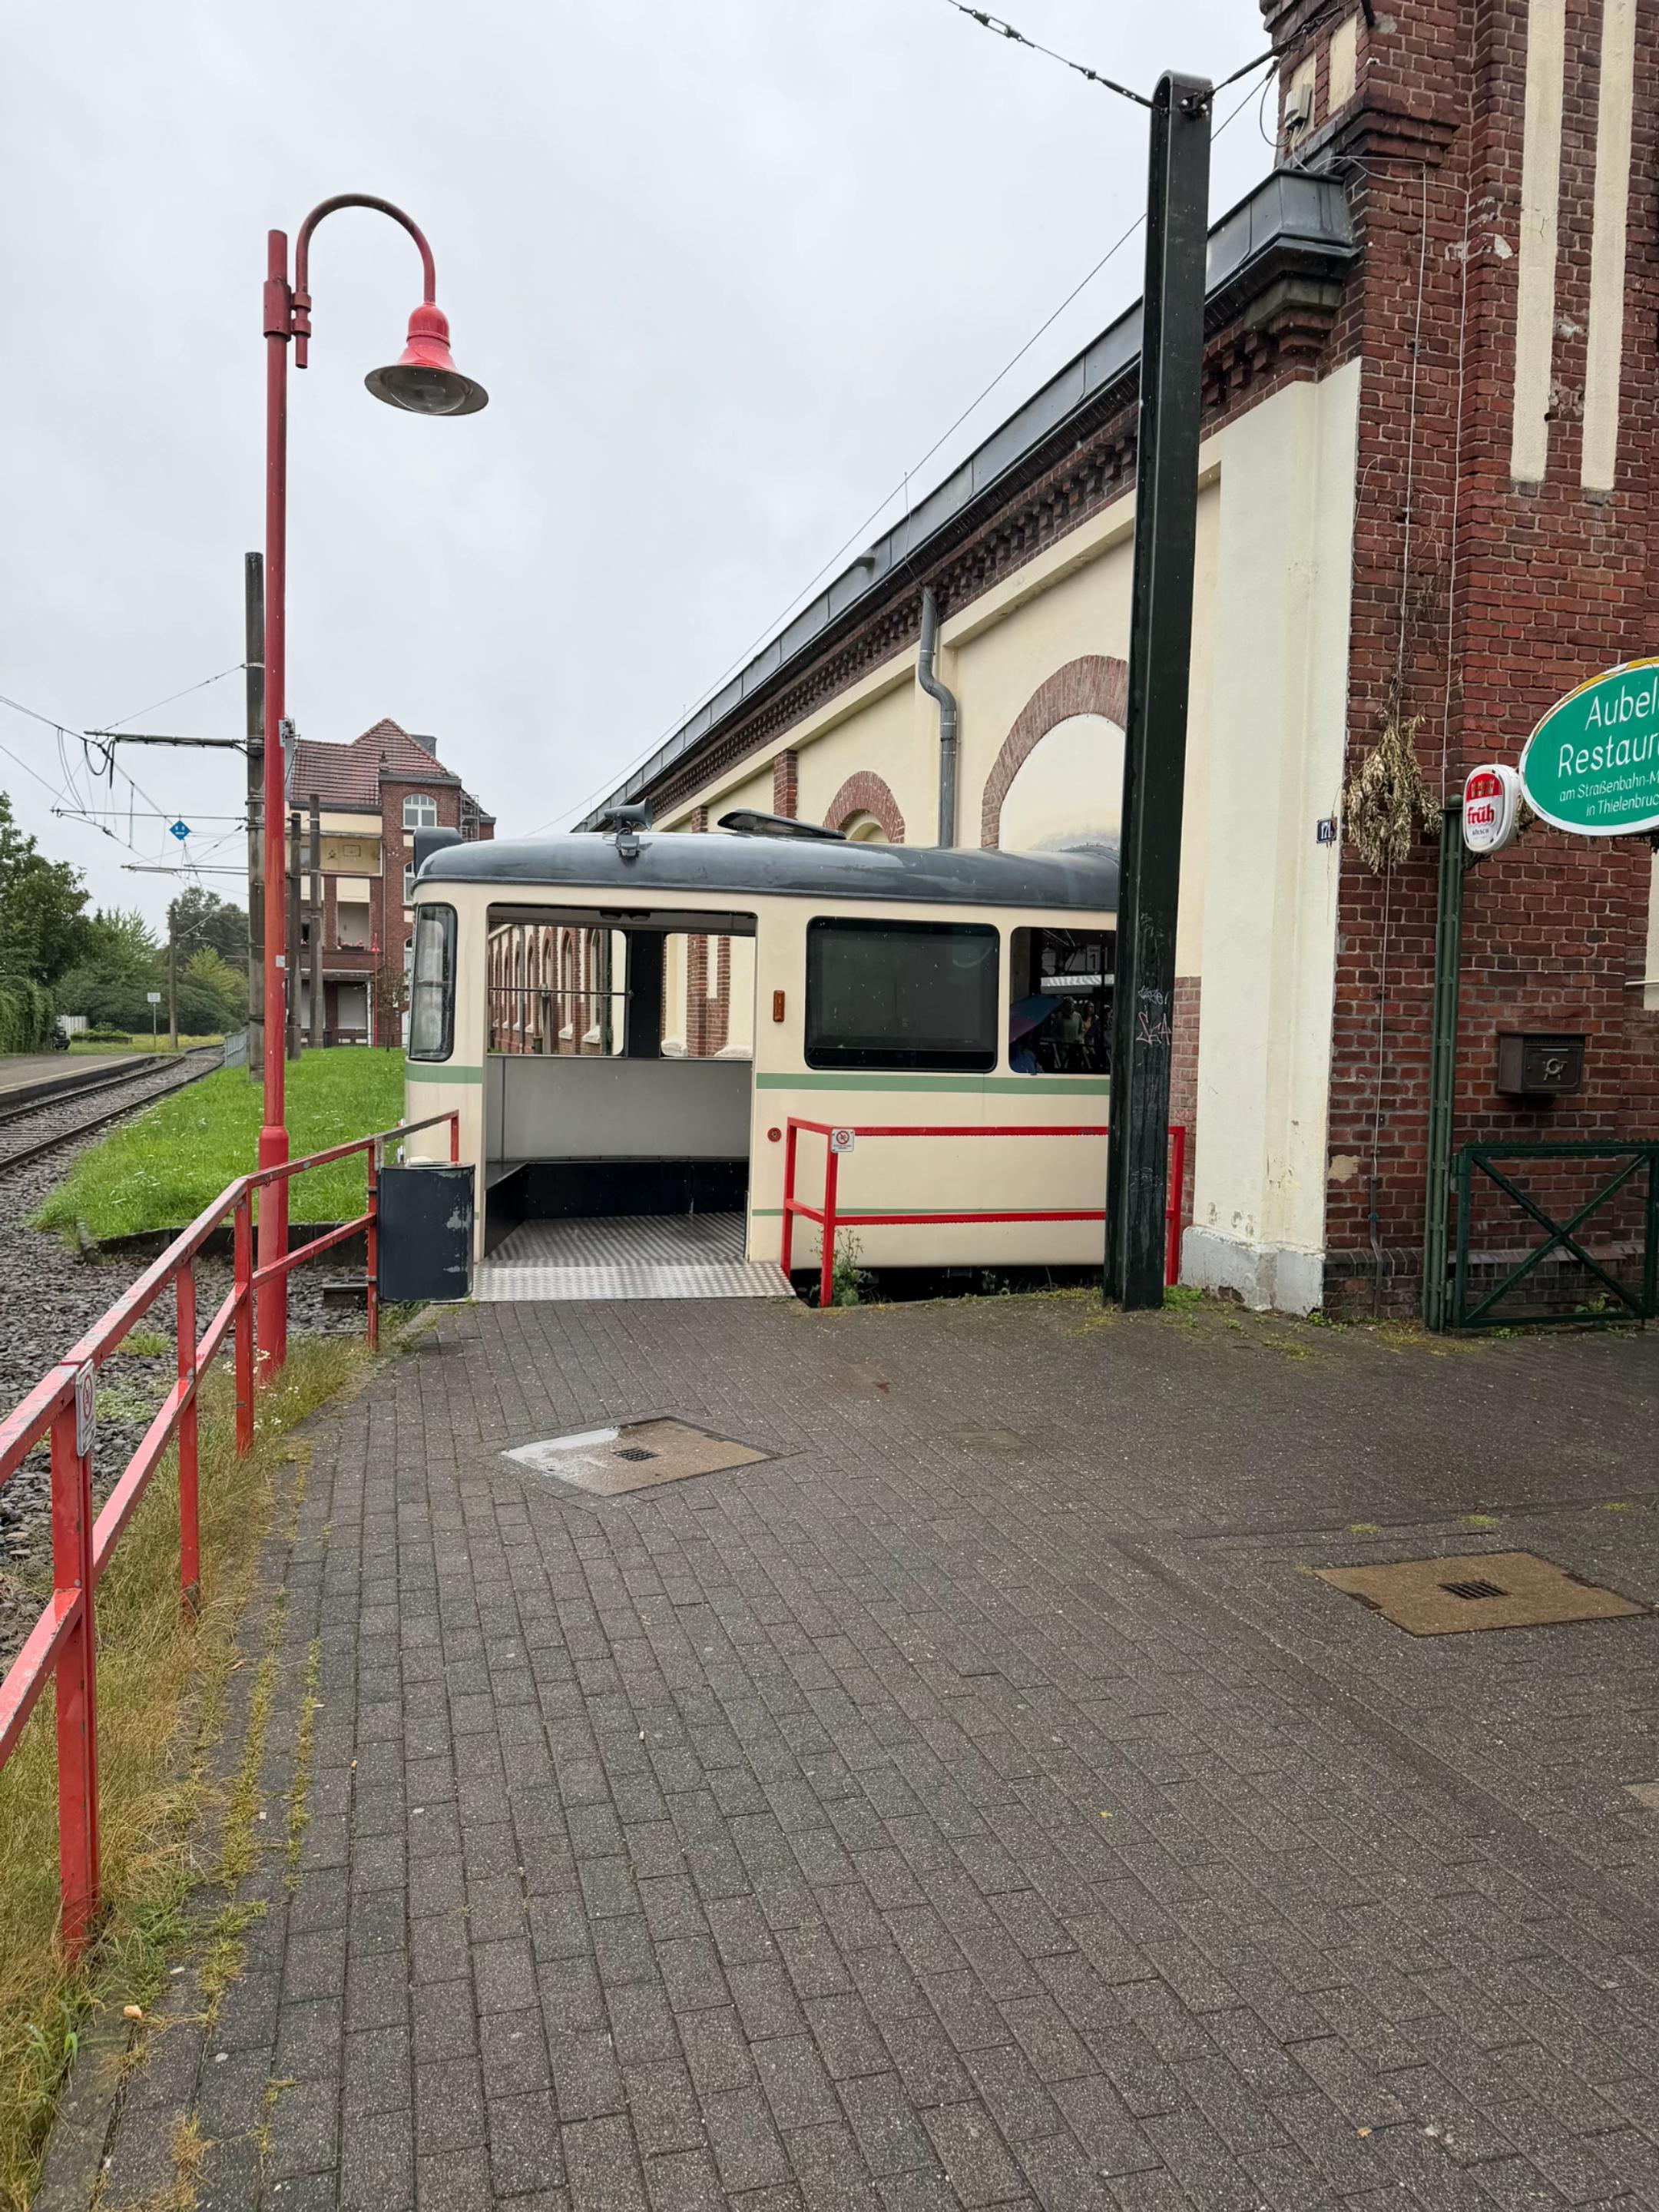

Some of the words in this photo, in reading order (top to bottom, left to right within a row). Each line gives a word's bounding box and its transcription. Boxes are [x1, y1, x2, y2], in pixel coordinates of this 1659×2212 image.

[1585, 676, 1659, 730] Aubel
[1558, 732, 1659, 778] Restaur
[1560, 789, 1575, 802] am
[1468, 803, 1495, 824] früh
[1586, 803, 1595, 816] in
